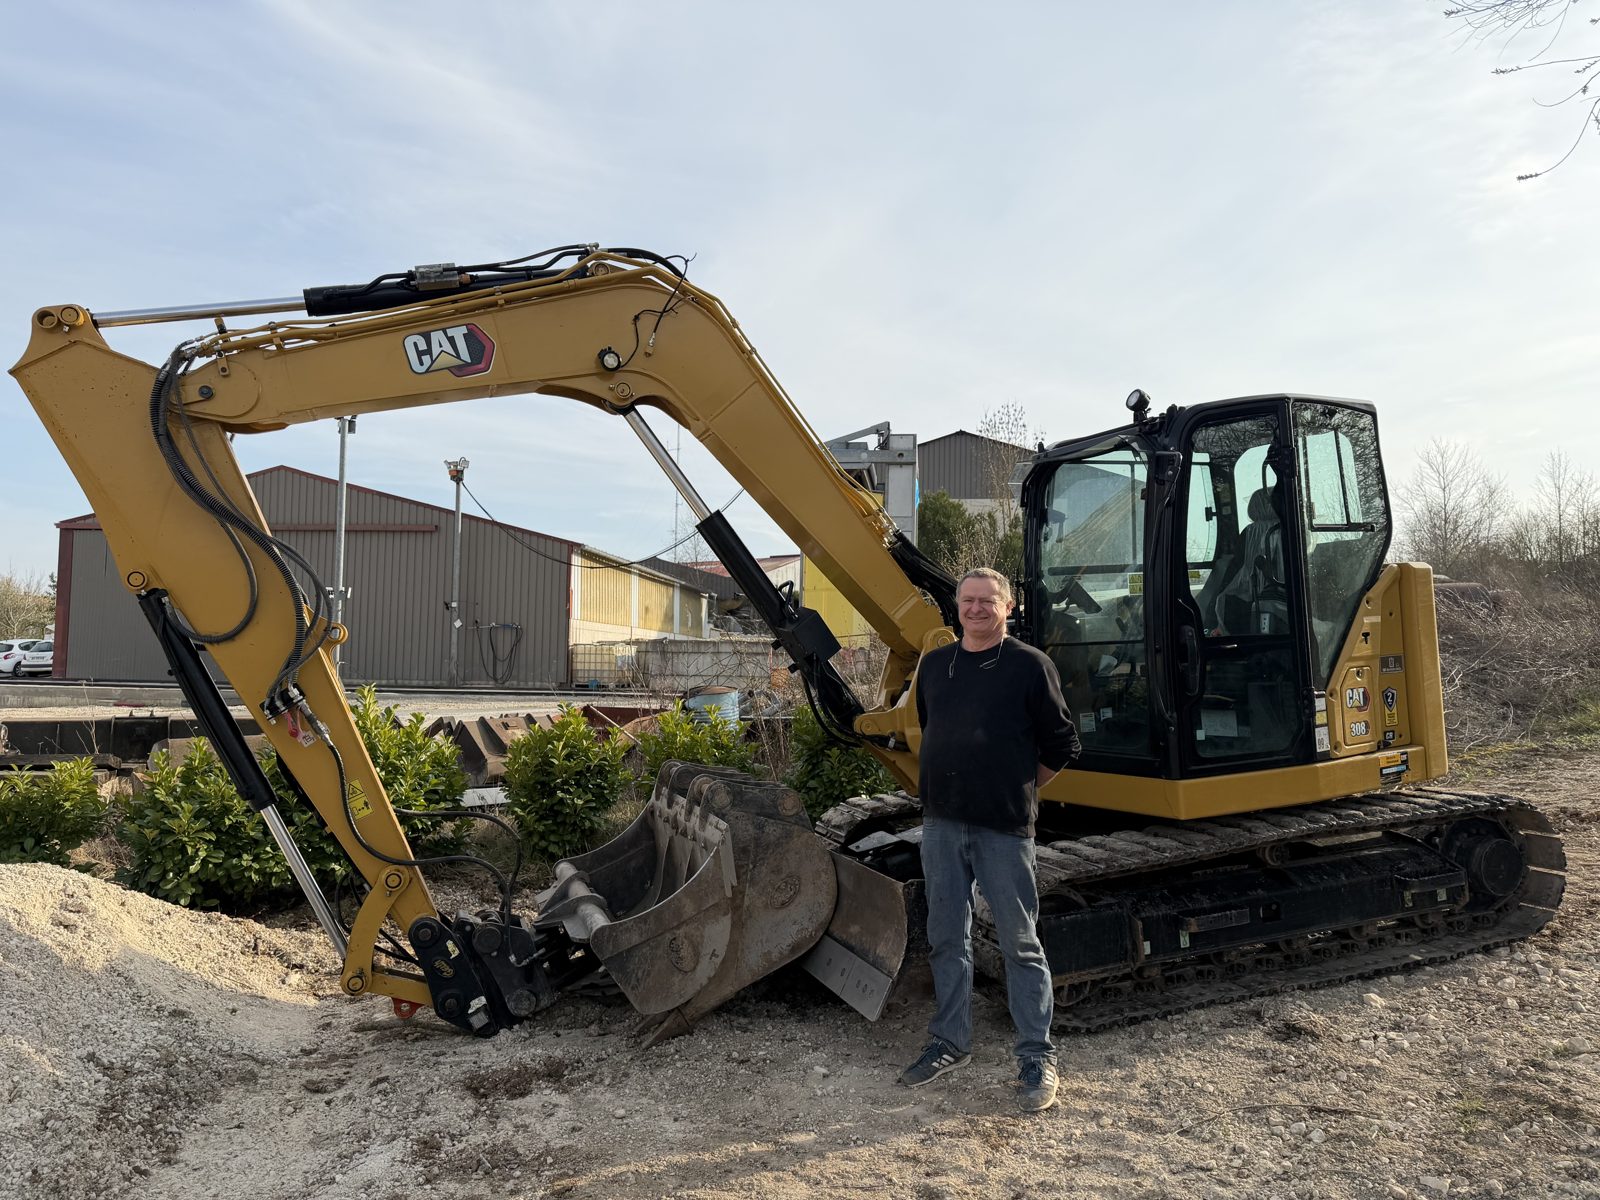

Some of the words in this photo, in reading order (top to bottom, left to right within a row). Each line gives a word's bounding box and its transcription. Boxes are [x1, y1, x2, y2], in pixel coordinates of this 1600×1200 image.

[403, 325, 472, 374] CAT
[1346, 687, 1364, 708] CAT
[1350, 721, 1366, 737] 308
